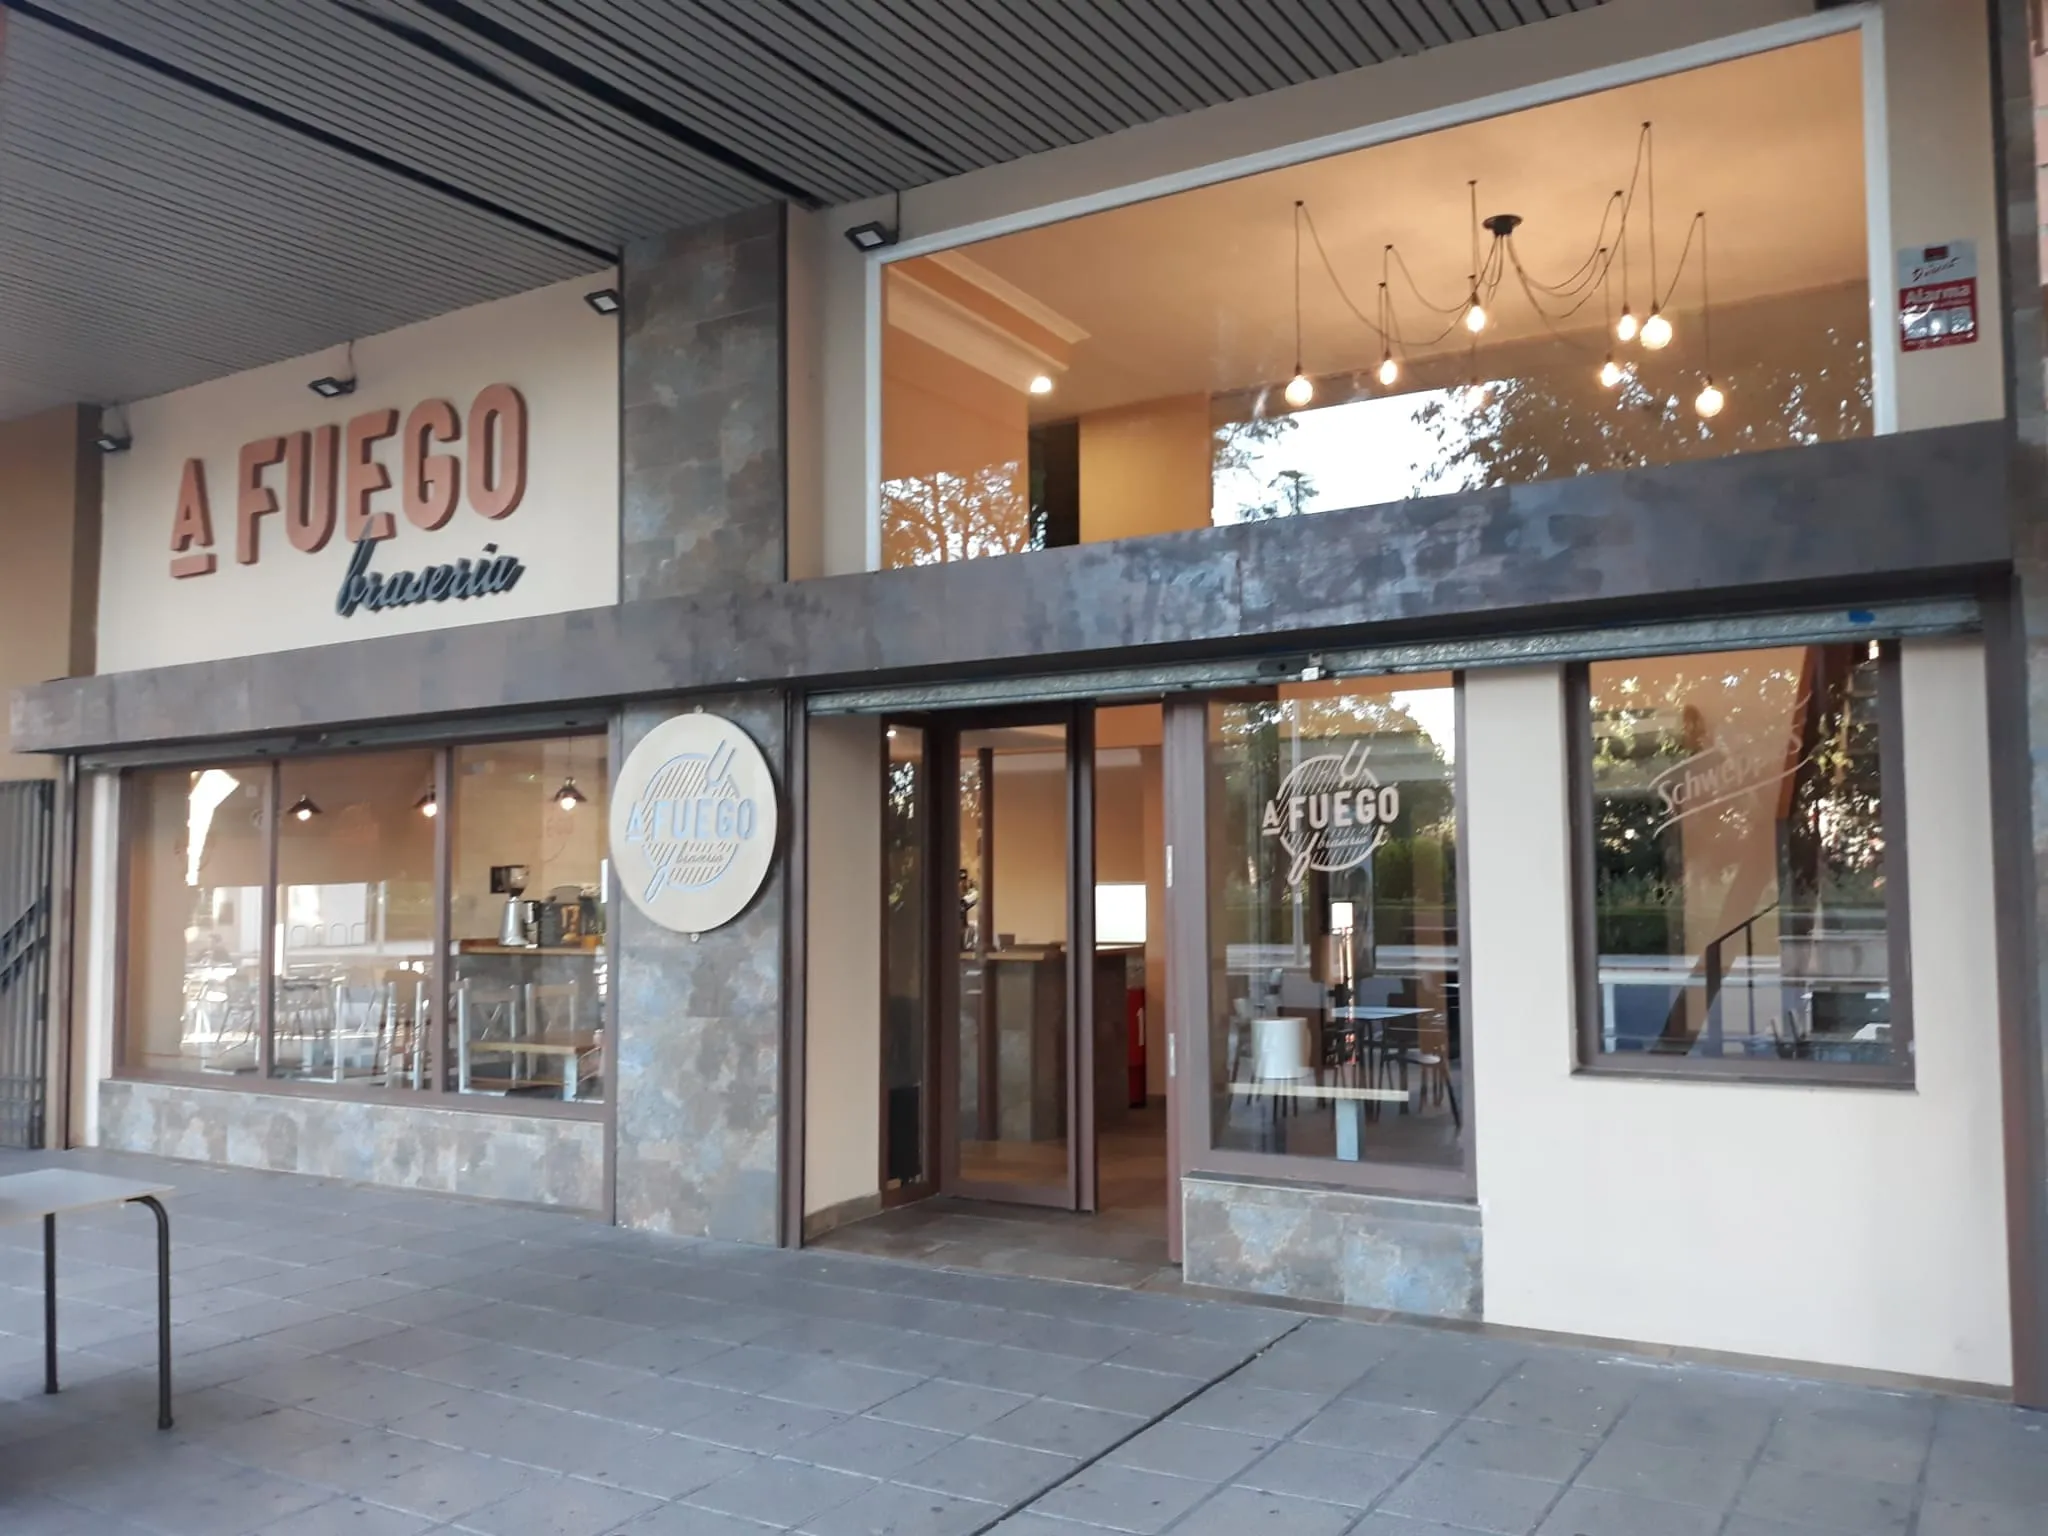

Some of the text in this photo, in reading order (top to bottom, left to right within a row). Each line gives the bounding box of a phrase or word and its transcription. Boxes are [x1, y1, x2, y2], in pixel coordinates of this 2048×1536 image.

[170, 382, 528, 579] A FUEGO
[625, 800, 645, 842] A
[653, 798, 756, 841] FUEGO
[1262, 786, 1399, 836] A FUEGO
